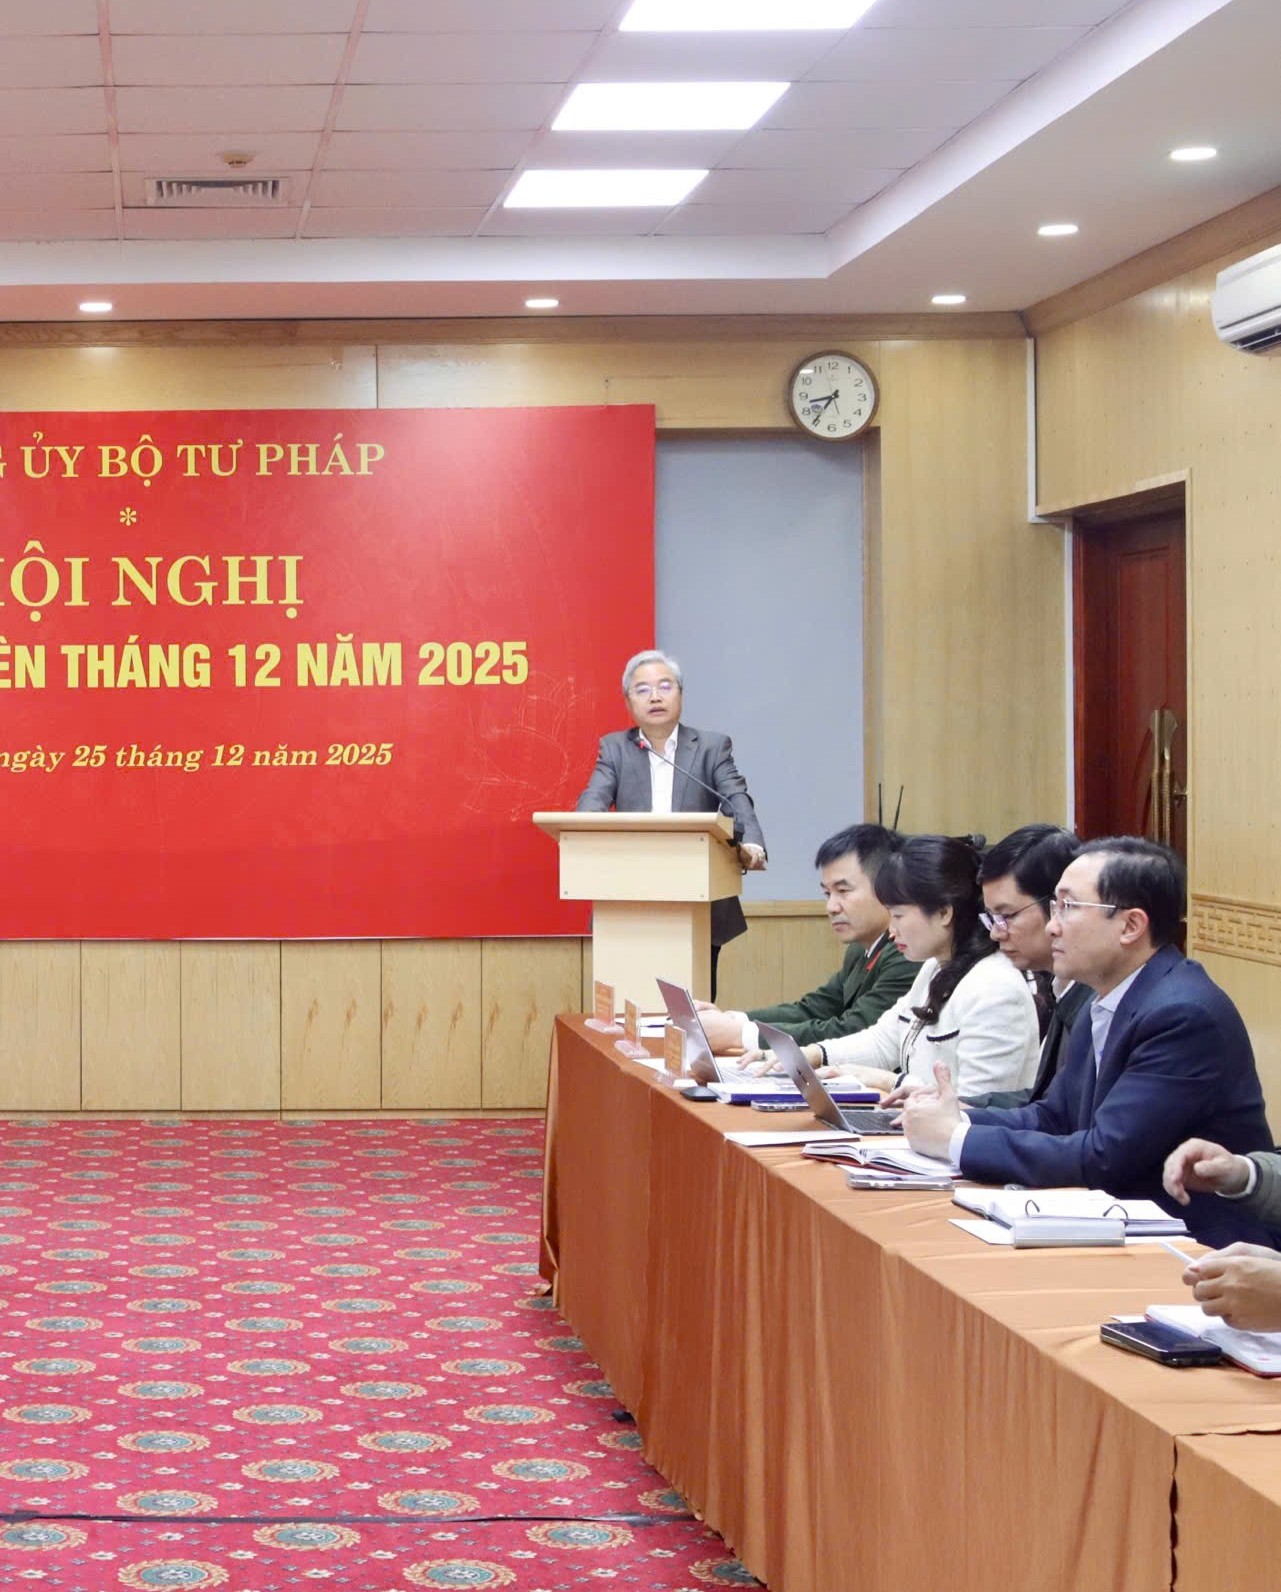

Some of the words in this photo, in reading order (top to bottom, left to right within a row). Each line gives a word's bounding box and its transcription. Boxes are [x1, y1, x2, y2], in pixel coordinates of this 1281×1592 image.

[828, 361, 839, 370] 12
[814, 366, 822, 374] 11
[802, 377, 812, 385] 10
[854, 379, 863, 387] 2
[799, 392, 808, 400] 9
[858, 393, 867, 402] 3
[802, 407, 811, 415] 8
[828, 424, 836, 432] 6
[843, 420, 851, 428] 5
[20, 431, 85, 478] ỦY
[98, 434, 163, 487] BỘ
[177, 439, 244, 477] TƯ
[256, 434, 386, 477] PHÁP
[111, 555, 304, 620] NGHỊ
[60, 634, 211, 689] THÁNG
[227, 643, 282, 688] 12
[296, 632, 403, 687] NĂM
[417, 640, 529, 686] 2025
[71, 744, 107, 767] 25
[115, 744, 204, 772] tháng
[212, 744, 245, 767] 12
[252, 744, 318, 767] năm
[324, 742, 394, 766] 2025
